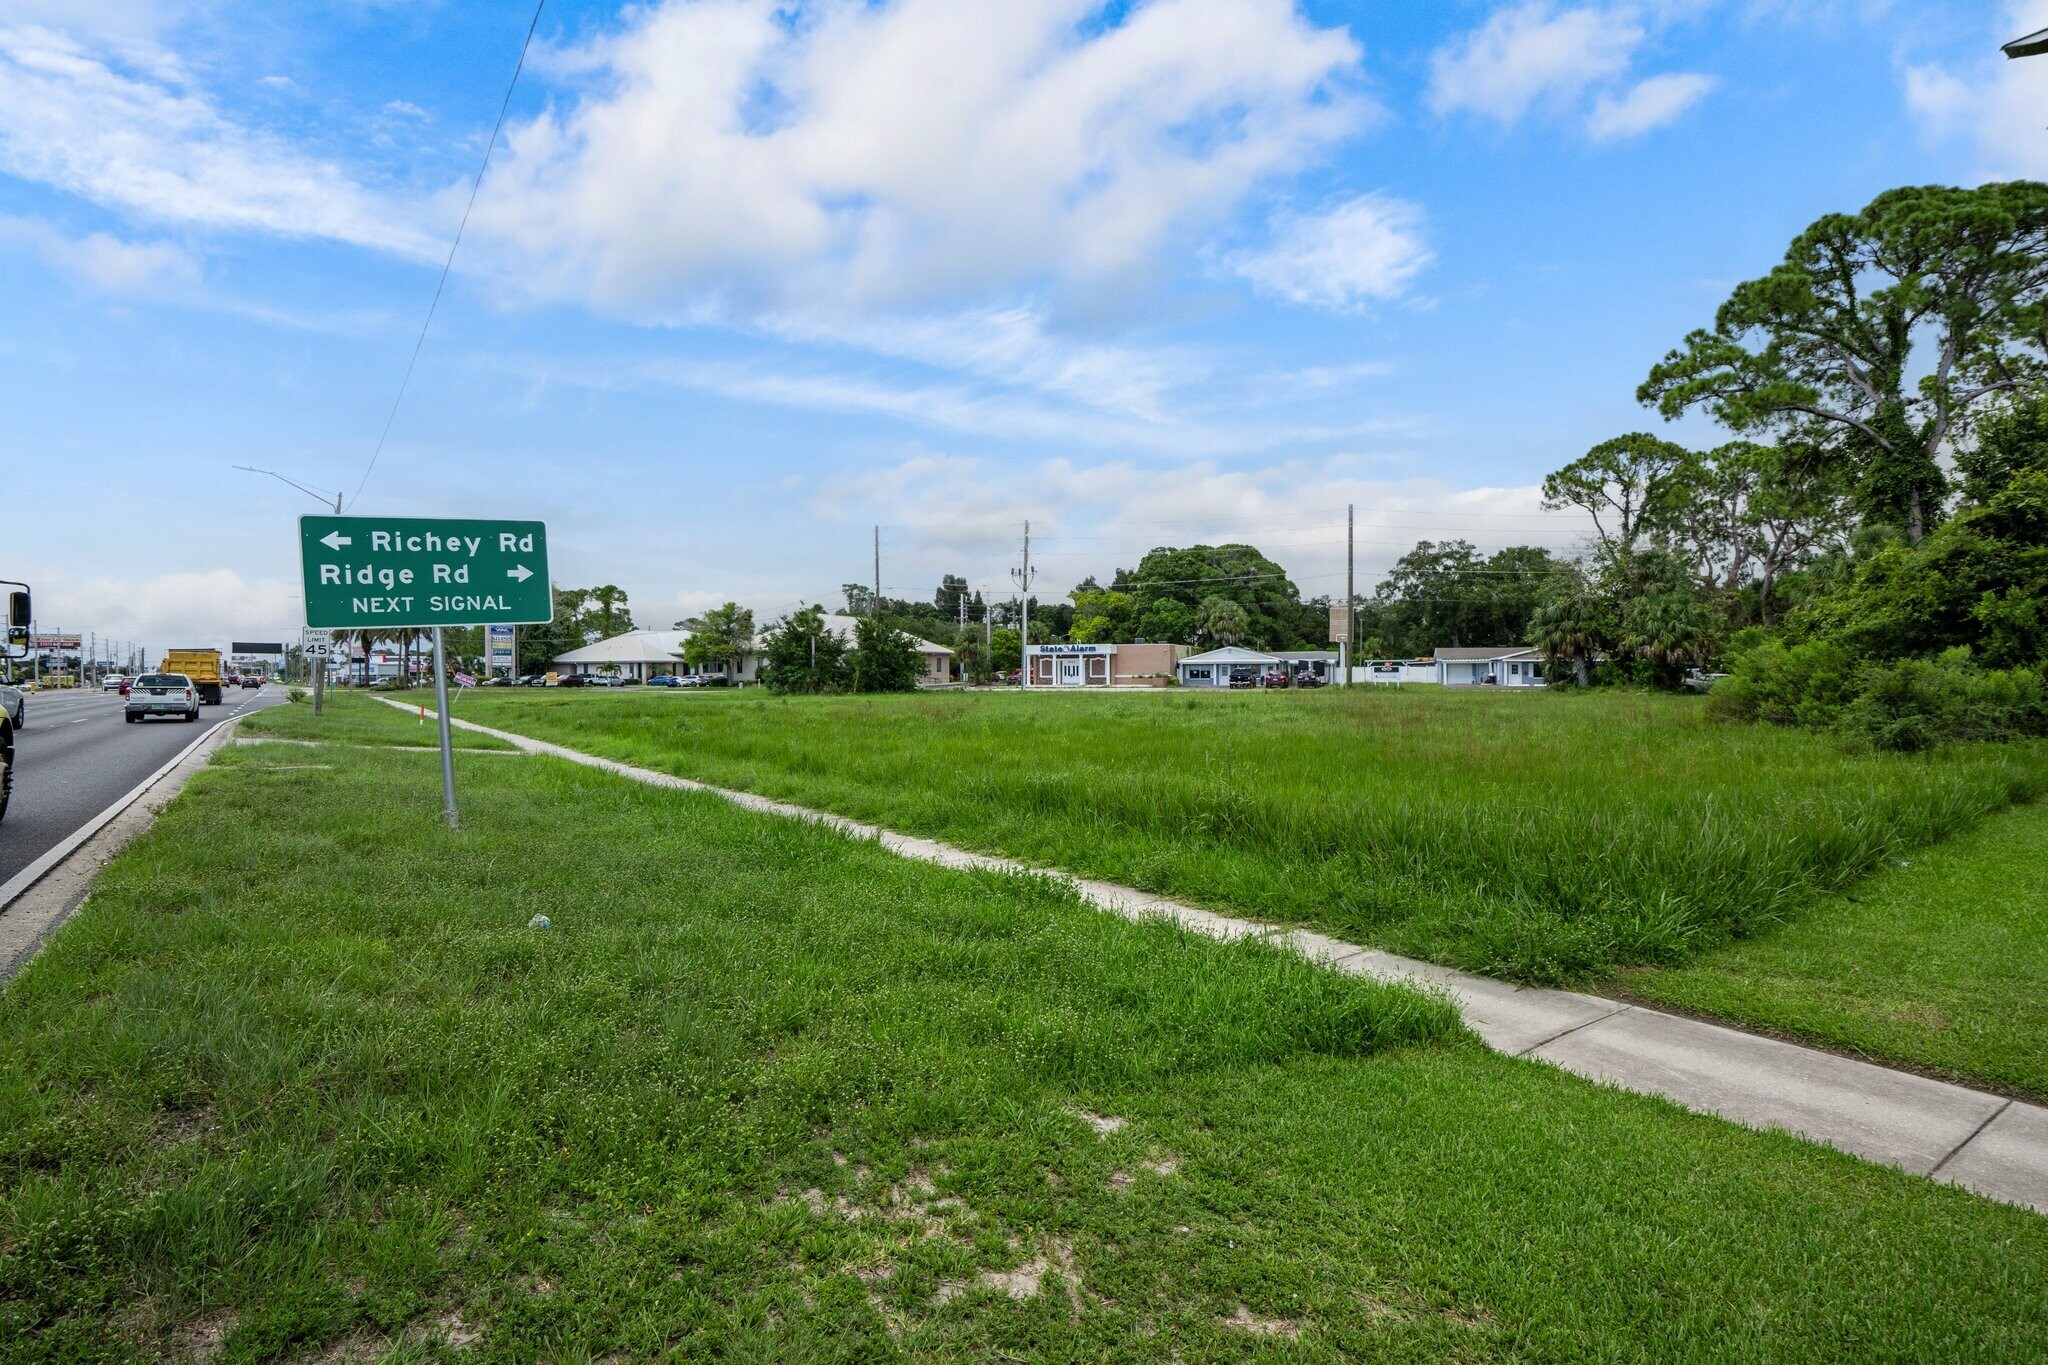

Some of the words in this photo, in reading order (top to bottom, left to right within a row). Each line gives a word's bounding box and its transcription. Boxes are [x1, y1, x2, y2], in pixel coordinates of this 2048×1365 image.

[371, 531, 481, 557] Richey
[499, 532, 533, 553] Rd
[320, 564, 414, 590] Ridge
[433, 564, 469, 584] Rd
[352, 597, 414, 614] NEXT
[429, 595, 512, 612] SIGNAL
[305, 645, 327, 655] 45
